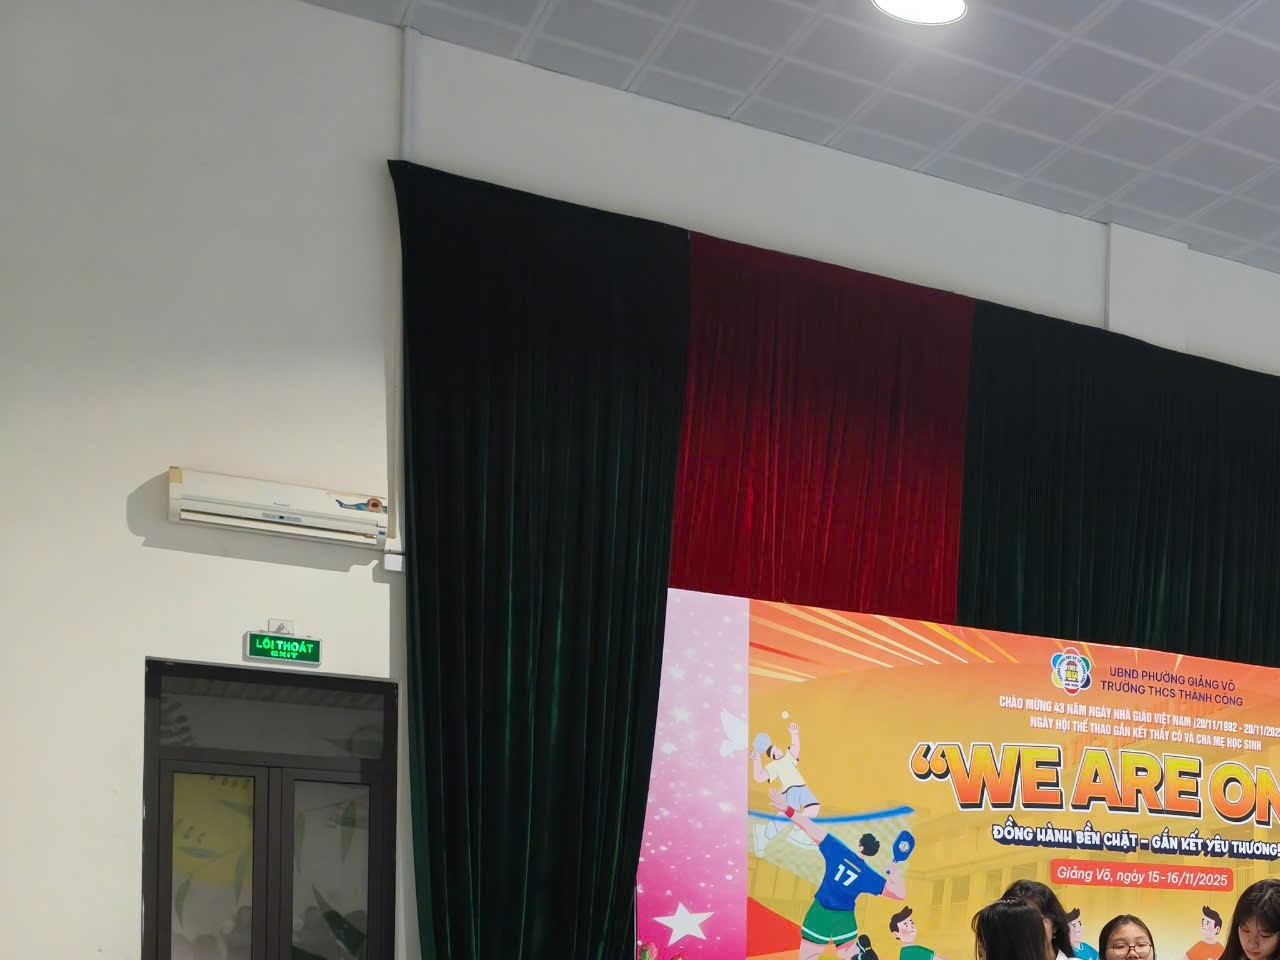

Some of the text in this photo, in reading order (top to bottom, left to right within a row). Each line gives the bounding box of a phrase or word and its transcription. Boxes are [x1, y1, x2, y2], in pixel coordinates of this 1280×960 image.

[276, 640, 313, 653] THOÁT
[1101, 680, 1145, 695] TRƯỜNG
[1148, 686, 1176, 698] THCS
[1110, 666, 1138, 679] UBND
[1142, 670, 1185, 685] PHƯỜNG
[1188, 675, 1219, 689] GIẢNG
[1054, 702, 1064, 714] 43
[1173, 715, 1191, 727] NAM
[1090, 722, 1111, 735] THAO
[1196, 734, 1211, 746] CHA
[1244, 738, 1262, 751] SINH
[1072, 746, 1203, 818] ARE
[992, 815, 1034, 843] ĐỒNG
[1036, 821, 1073, 845] HÀNH
[1075, 820, 1101, 846] BỀN
[1103, 829, 1138, 850] CHẶT
[1151, 827, 1178, 850] GẮN
[1180, 828, 1204, 851] KẾT
[1205, 834, 1229, 854] YÊU
[1231, 838, 1280, 858] THƯƠNG!
[834, 863, 858, 887] 17
[1057, 866, 1093, 884] Giảng
[1117, 868, 1145, 885] ngày
[1148, 870, 1228, 887] 15-16/11/2025
